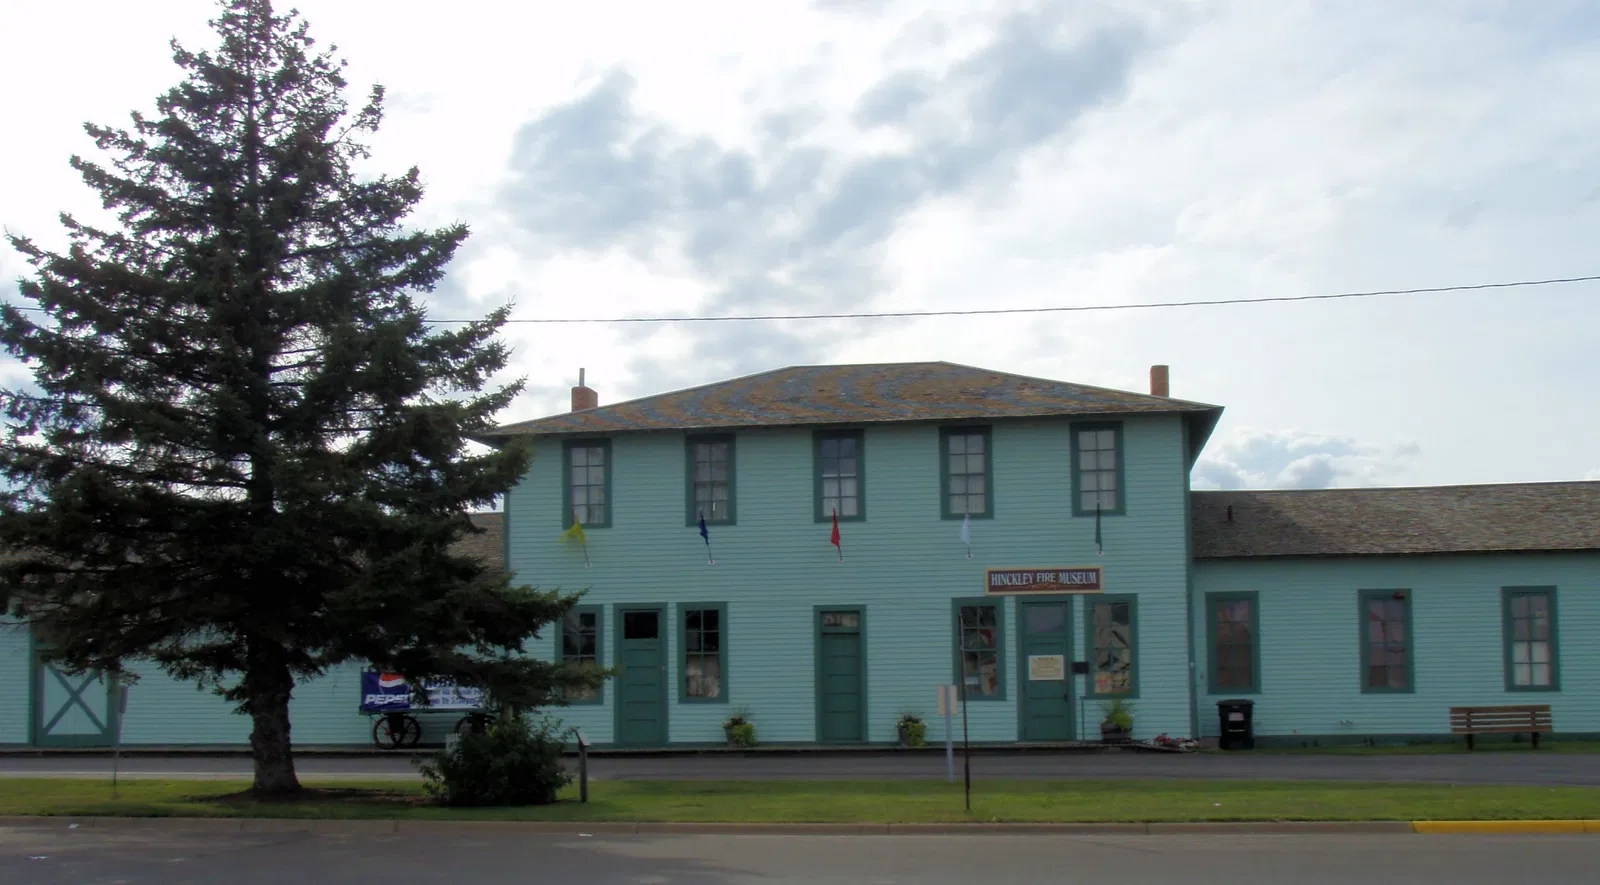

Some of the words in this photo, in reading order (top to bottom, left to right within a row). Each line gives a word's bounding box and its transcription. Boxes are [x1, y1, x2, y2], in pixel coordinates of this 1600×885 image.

[991, 572, 1034, 586] HINCKLEY
[1036, 572, 1056, 583] FIRE
[1058, 571, 1097, 585] MUSEUM
[365, 693, 409, 705] PEPSI
